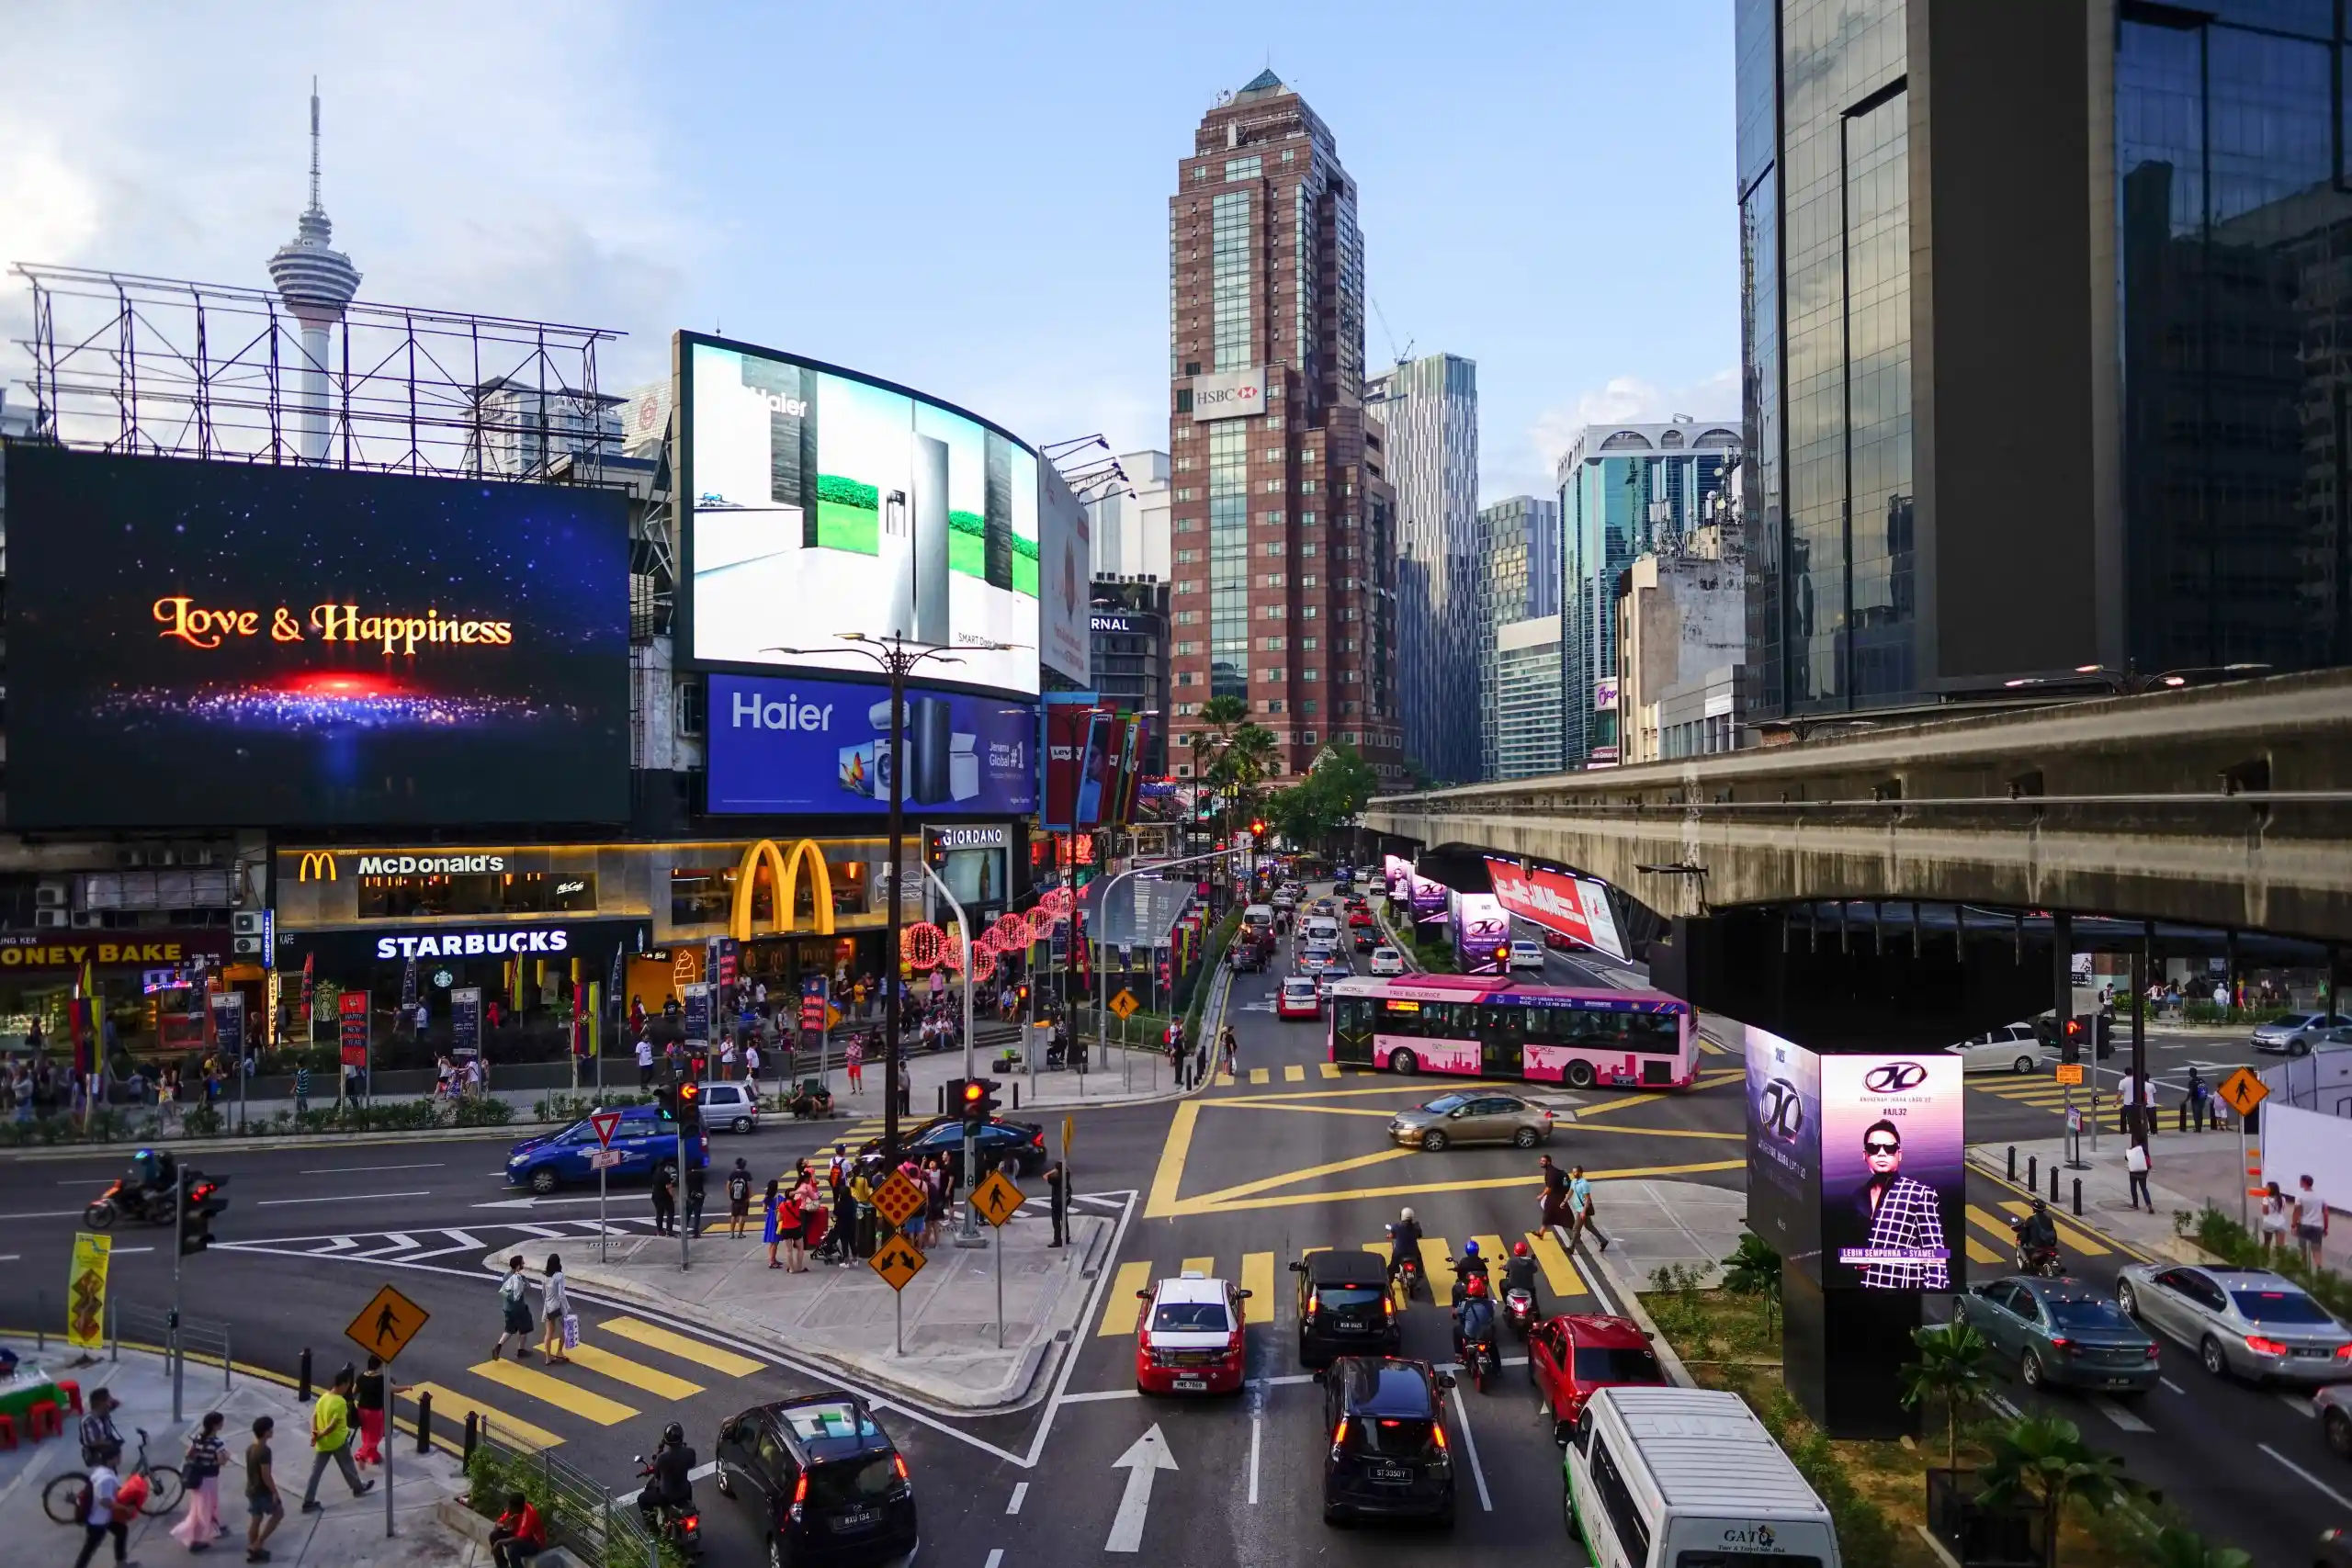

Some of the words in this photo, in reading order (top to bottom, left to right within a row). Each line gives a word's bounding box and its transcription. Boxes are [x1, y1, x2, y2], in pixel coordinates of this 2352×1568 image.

[1196, 388, 1235, 405] HSBC
[153, 596, 259, 649] Love
[271, 607, 305, 642] &
[311, 604, 513, 655] Happiness
[958, 632, 978, 645] SMART
[732, 692, 833, 731] Haier
[989, 753, 1010, 767] Global
[1010, 741, 1024, 769] #1
[942, 829, 1001, 845] GIORDANO
[358, 855, 504, 874] McDonald's
[279, 934, 294, 944] KAFE
[378, 930, 568, 959] STARBUCKS
[98, 943, 182, 963] BAKE
[1883, 1108, 1907, 1116] #AJL32
[1843, 1248, 1863, 1257] LEBIH
[1864, 1248, 1902, 1258] SEMPURNA
[1909, 1248, 1936, 1258] SYAMEL
[859, 1512, 870, 1521] 134
[1724, 1529, 1770, 1546] GATO
